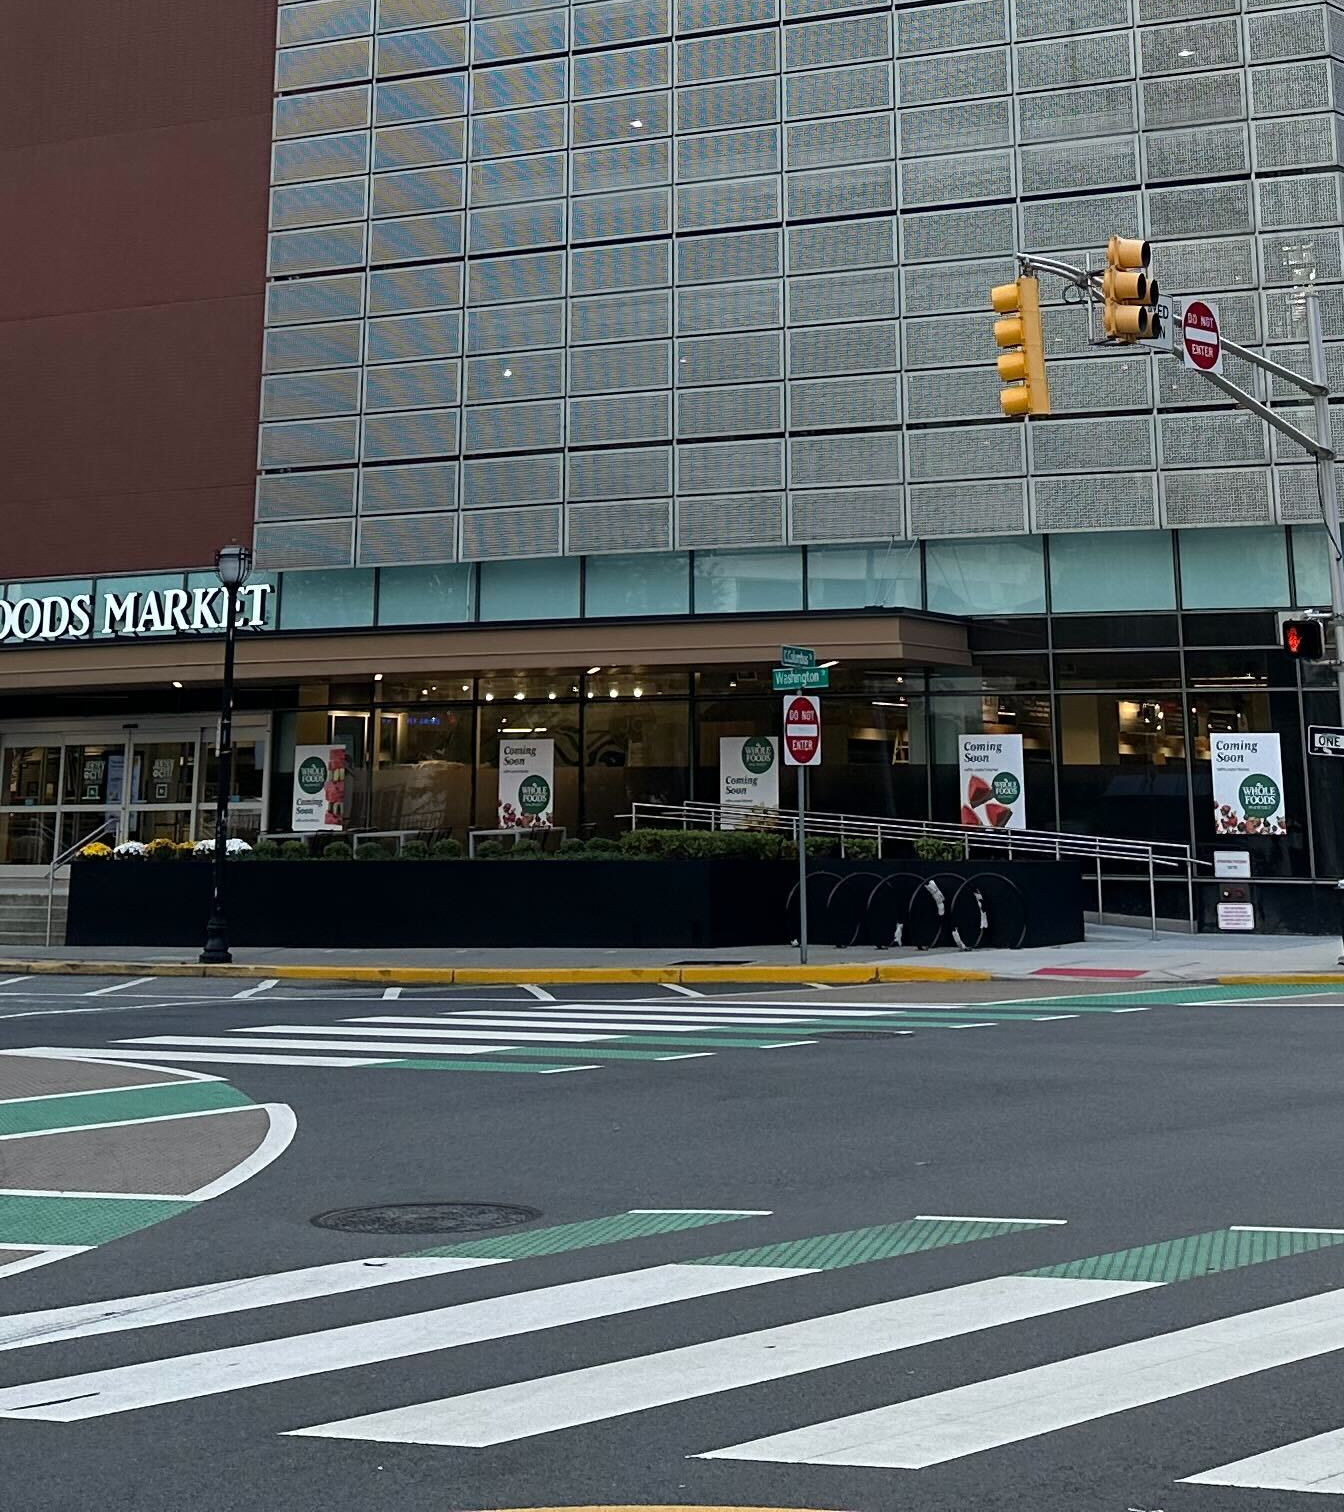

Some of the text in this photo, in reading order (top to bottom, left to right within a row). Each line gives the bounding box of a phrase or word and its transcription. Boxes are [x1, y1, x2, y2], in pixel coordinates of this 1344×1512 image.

[1187, 312, 1214, 328] DO NOT
[1191, 343, 1214, 358] ENTER
[101, 583, 272, 634] MARKET
[775, 671, 820, 687] Washington
[789, 709, 815, 721] DO NOT
[792, 739, 814, 751] ENTER
[963, 740, 1002, 754] Coming
[1216, 740, 1258, 753] Coming
[1318, 735, 1341, 748] ONE
[503, 745, 537, 757] Coming
[745, 742, 771, 754] WHOLE
[503, 757, 525, 766] Soon
[963, 752, 989, 763] Soon
[1215, 752, 1244, 763] Soon
[300, 763, 326, 776] WHOLE
[725, 776, 758, 786] Coming
[725, 785, 747, 795] Soon
[1242, 783, 1276, 796] WHOLE
[296, 798, 323, 807] Coming
[1244, 795, 1276, 805] FOODS
[296, 807, 314, 815] Soon
